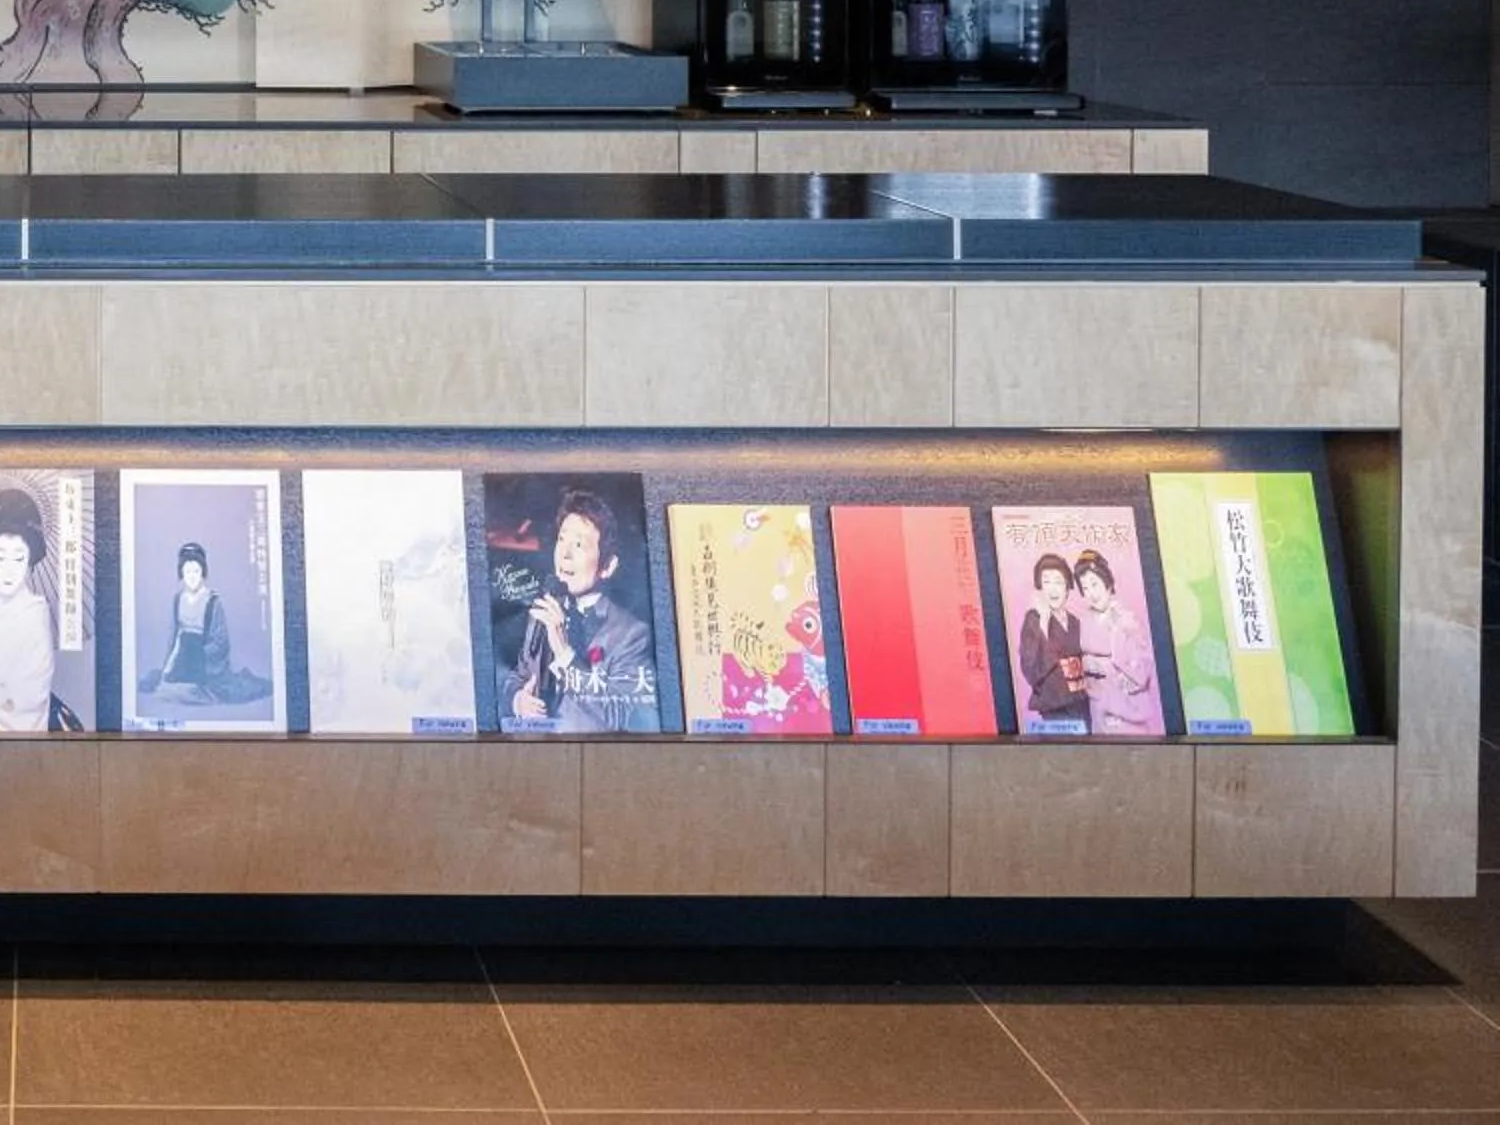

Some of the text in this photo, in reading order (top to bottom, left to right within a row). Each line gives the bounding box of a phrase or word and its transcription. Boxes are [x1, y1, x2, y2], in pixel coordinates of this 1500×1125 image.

[1227, 509, 1264, 644] 松竹大歌舞伎
[960, 604, 984, 671] 歌舞伎
[563, 666, 655, 694] 舟木一夫
